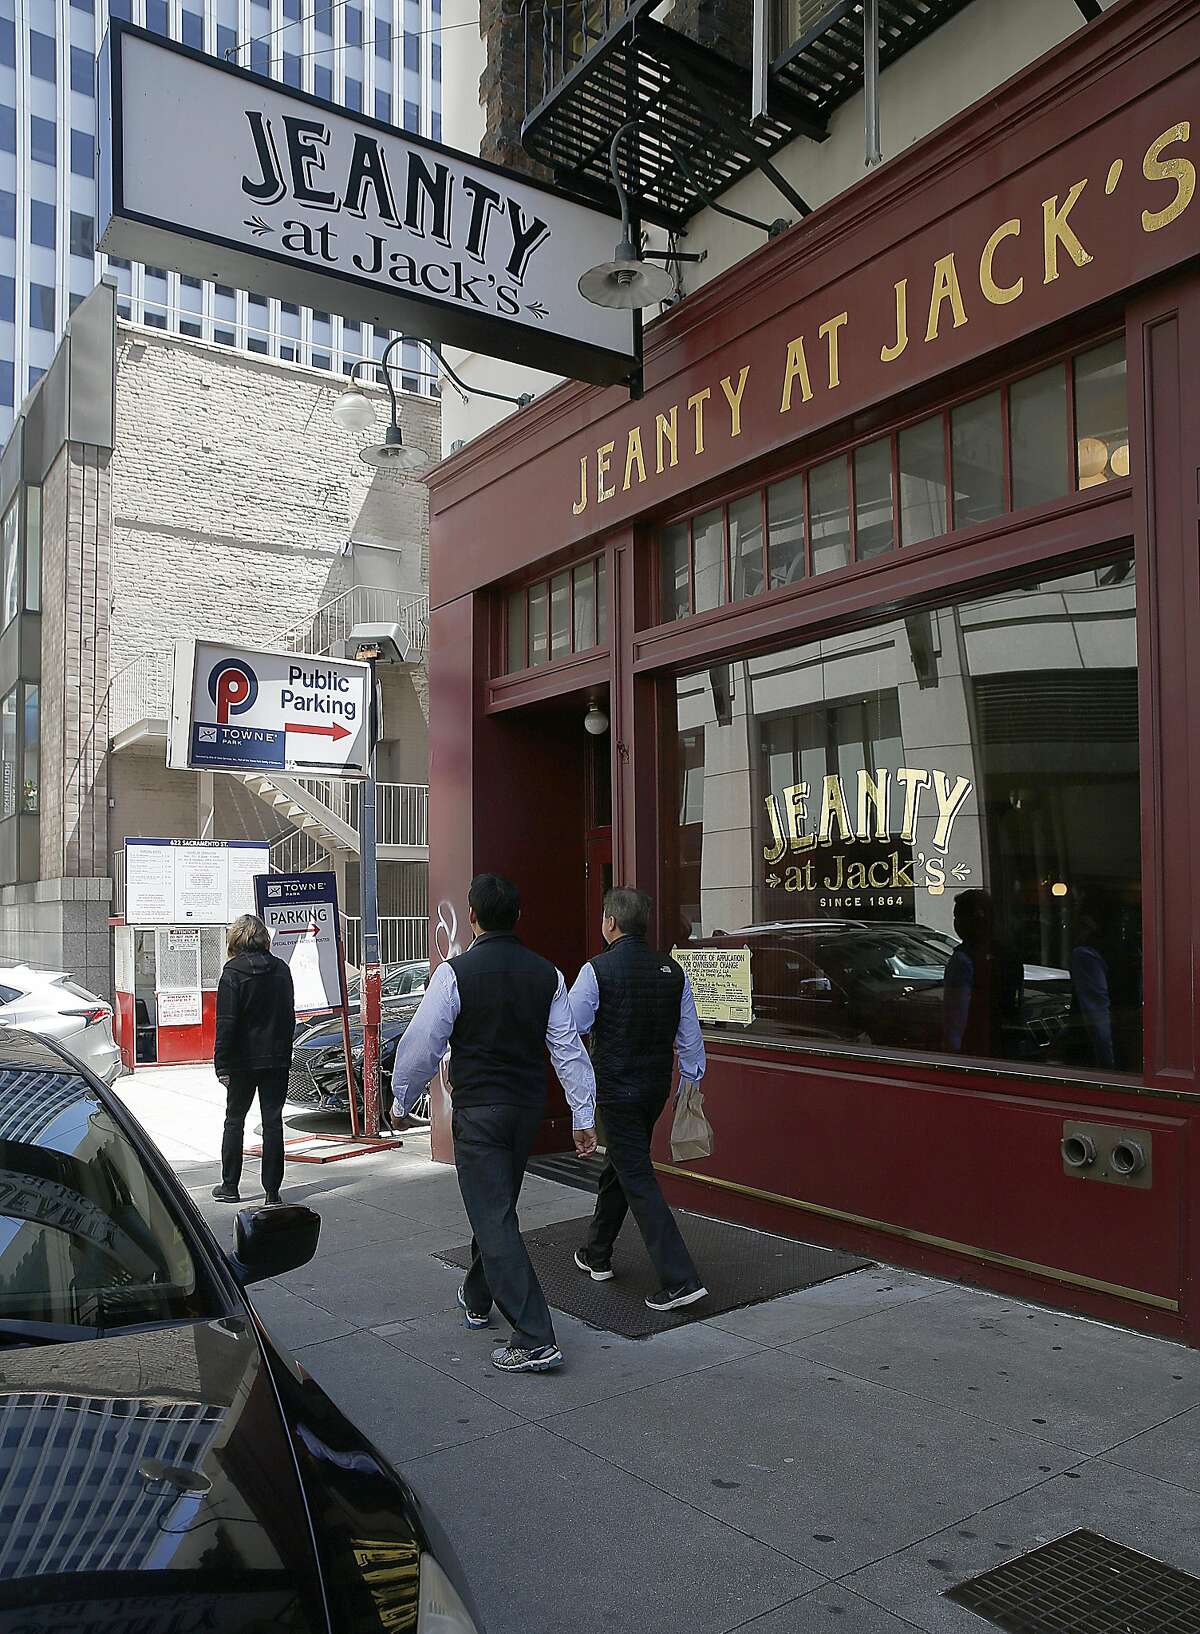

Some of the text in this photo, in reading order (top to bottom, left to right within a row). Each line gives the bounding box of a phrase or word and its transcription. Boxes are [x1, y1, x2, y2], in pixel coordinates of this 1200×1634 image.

[241, 110, 550, 287] JEANTY
[282, 220, 521, 316] at Jack's
[572, 121, 1197, 515] JEANTY AT JACK'S
[288, 665, 350, 693] Public
[280, 689, 356, 720] Parking
[221, 728, 276, 743] TOWNE
[763, 768, 973, 864] JEANTY
[784, 851, 947, 892] at Jack's
[284, 882, 325, 892] TOWNE
[820, 896, 904, 907] SINCE 1864
[270, 908, 327, 925] PARKING
[717, 954, 745, 962] APPLICATION
[720, 961, 739, 969] CHANGE
